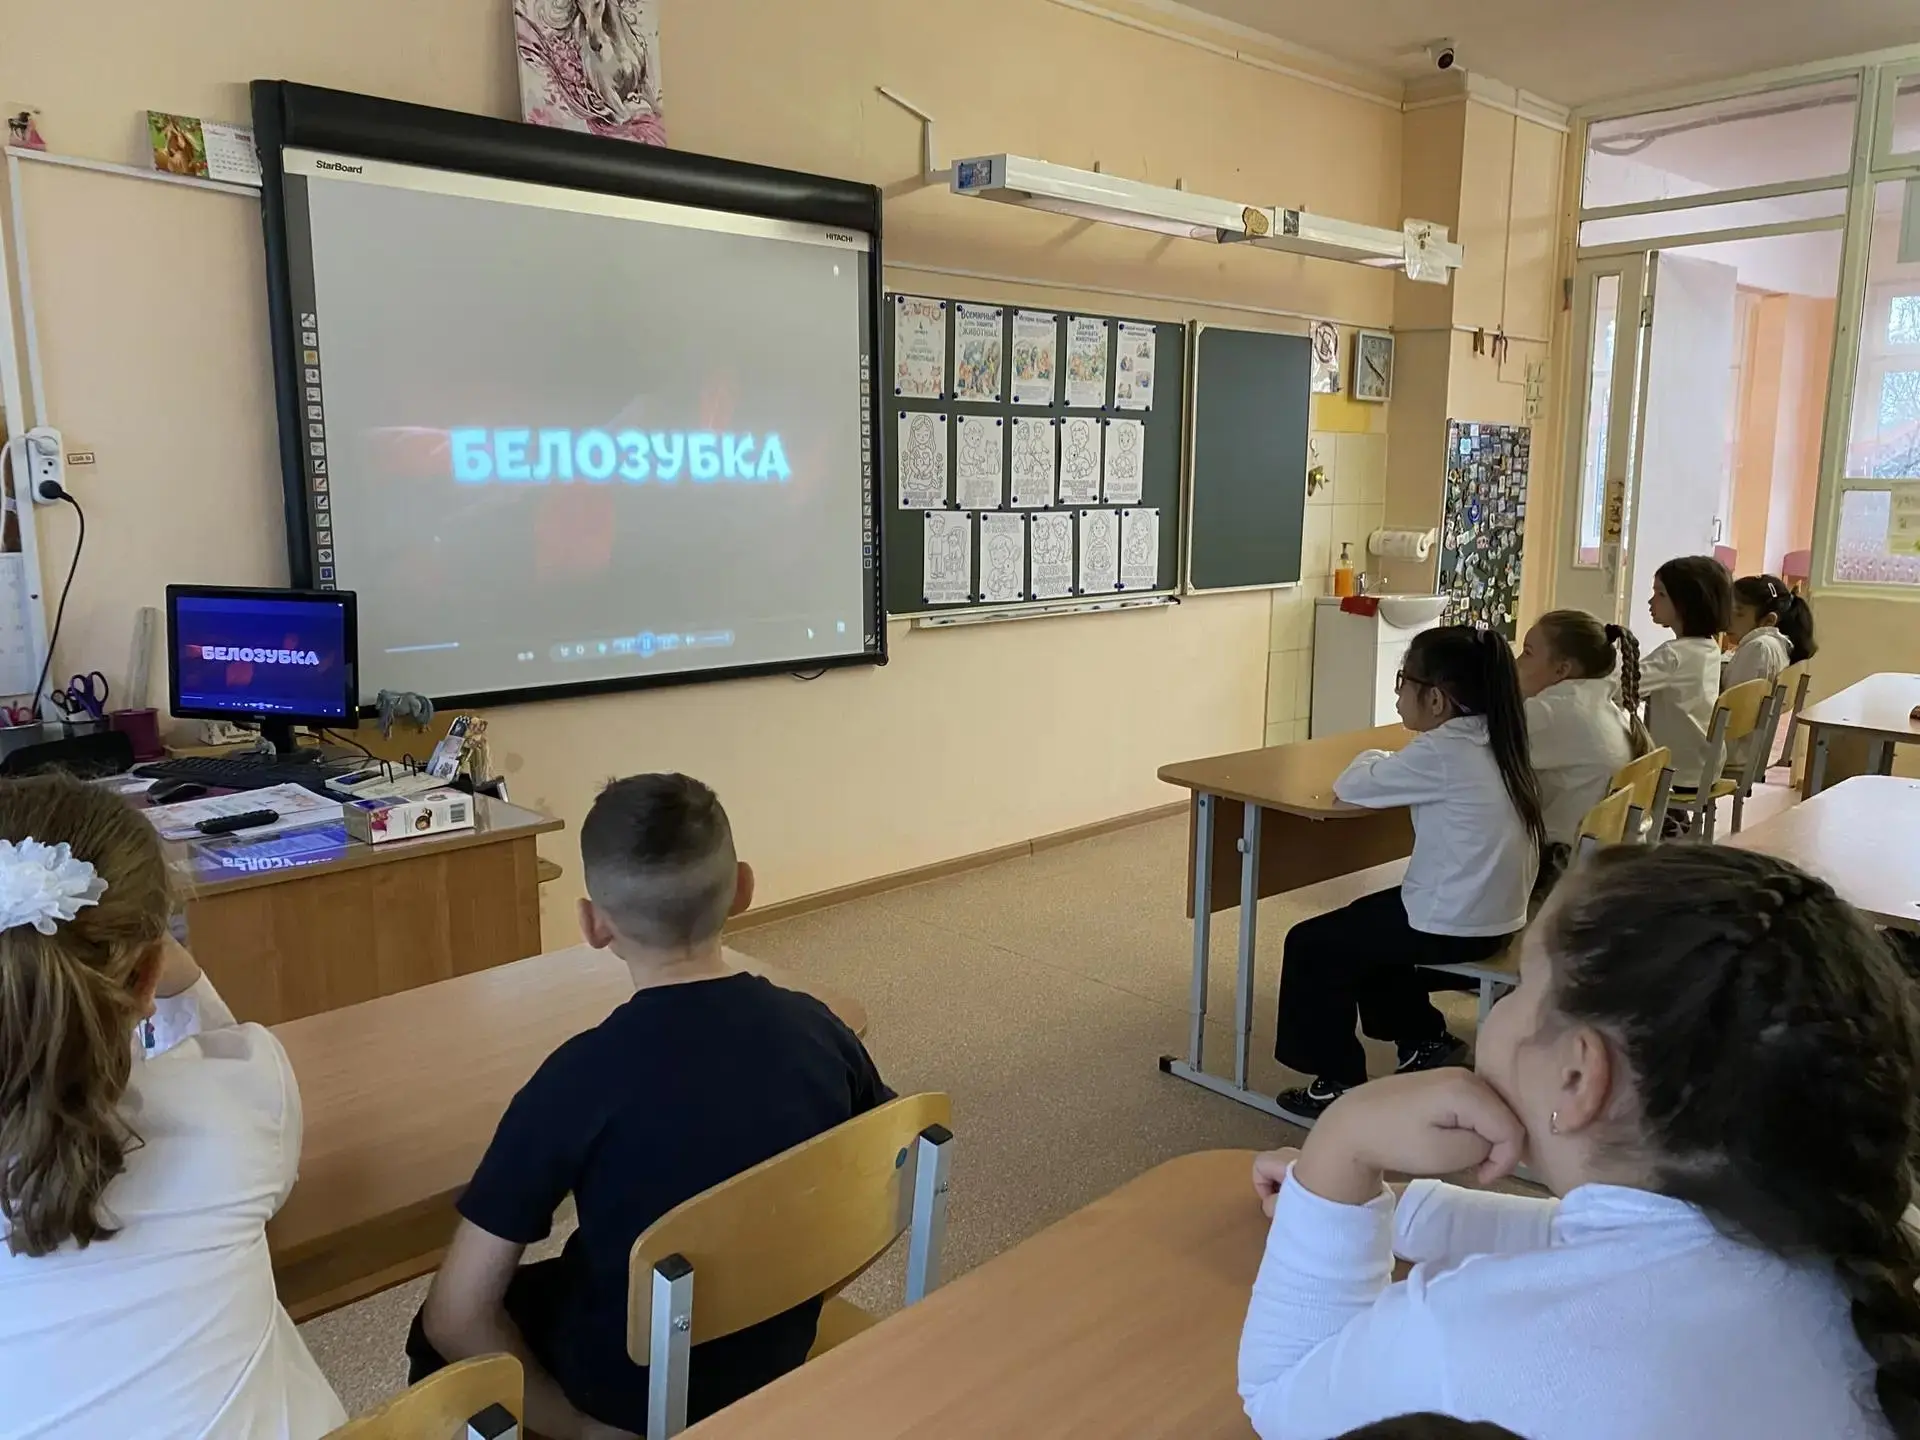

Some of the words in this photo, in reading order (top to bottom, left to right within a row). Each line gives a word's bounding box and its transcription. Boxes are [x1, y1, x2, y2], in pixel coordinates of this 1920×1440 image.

[316, 159, 363, 174] StarBoard
[825, 232, 853, 243] HITACHI
[450, 427, 793, 484] БЕЛОЗУБКА
[202, 646, 320, 666] БЕЛОЗУБКА
